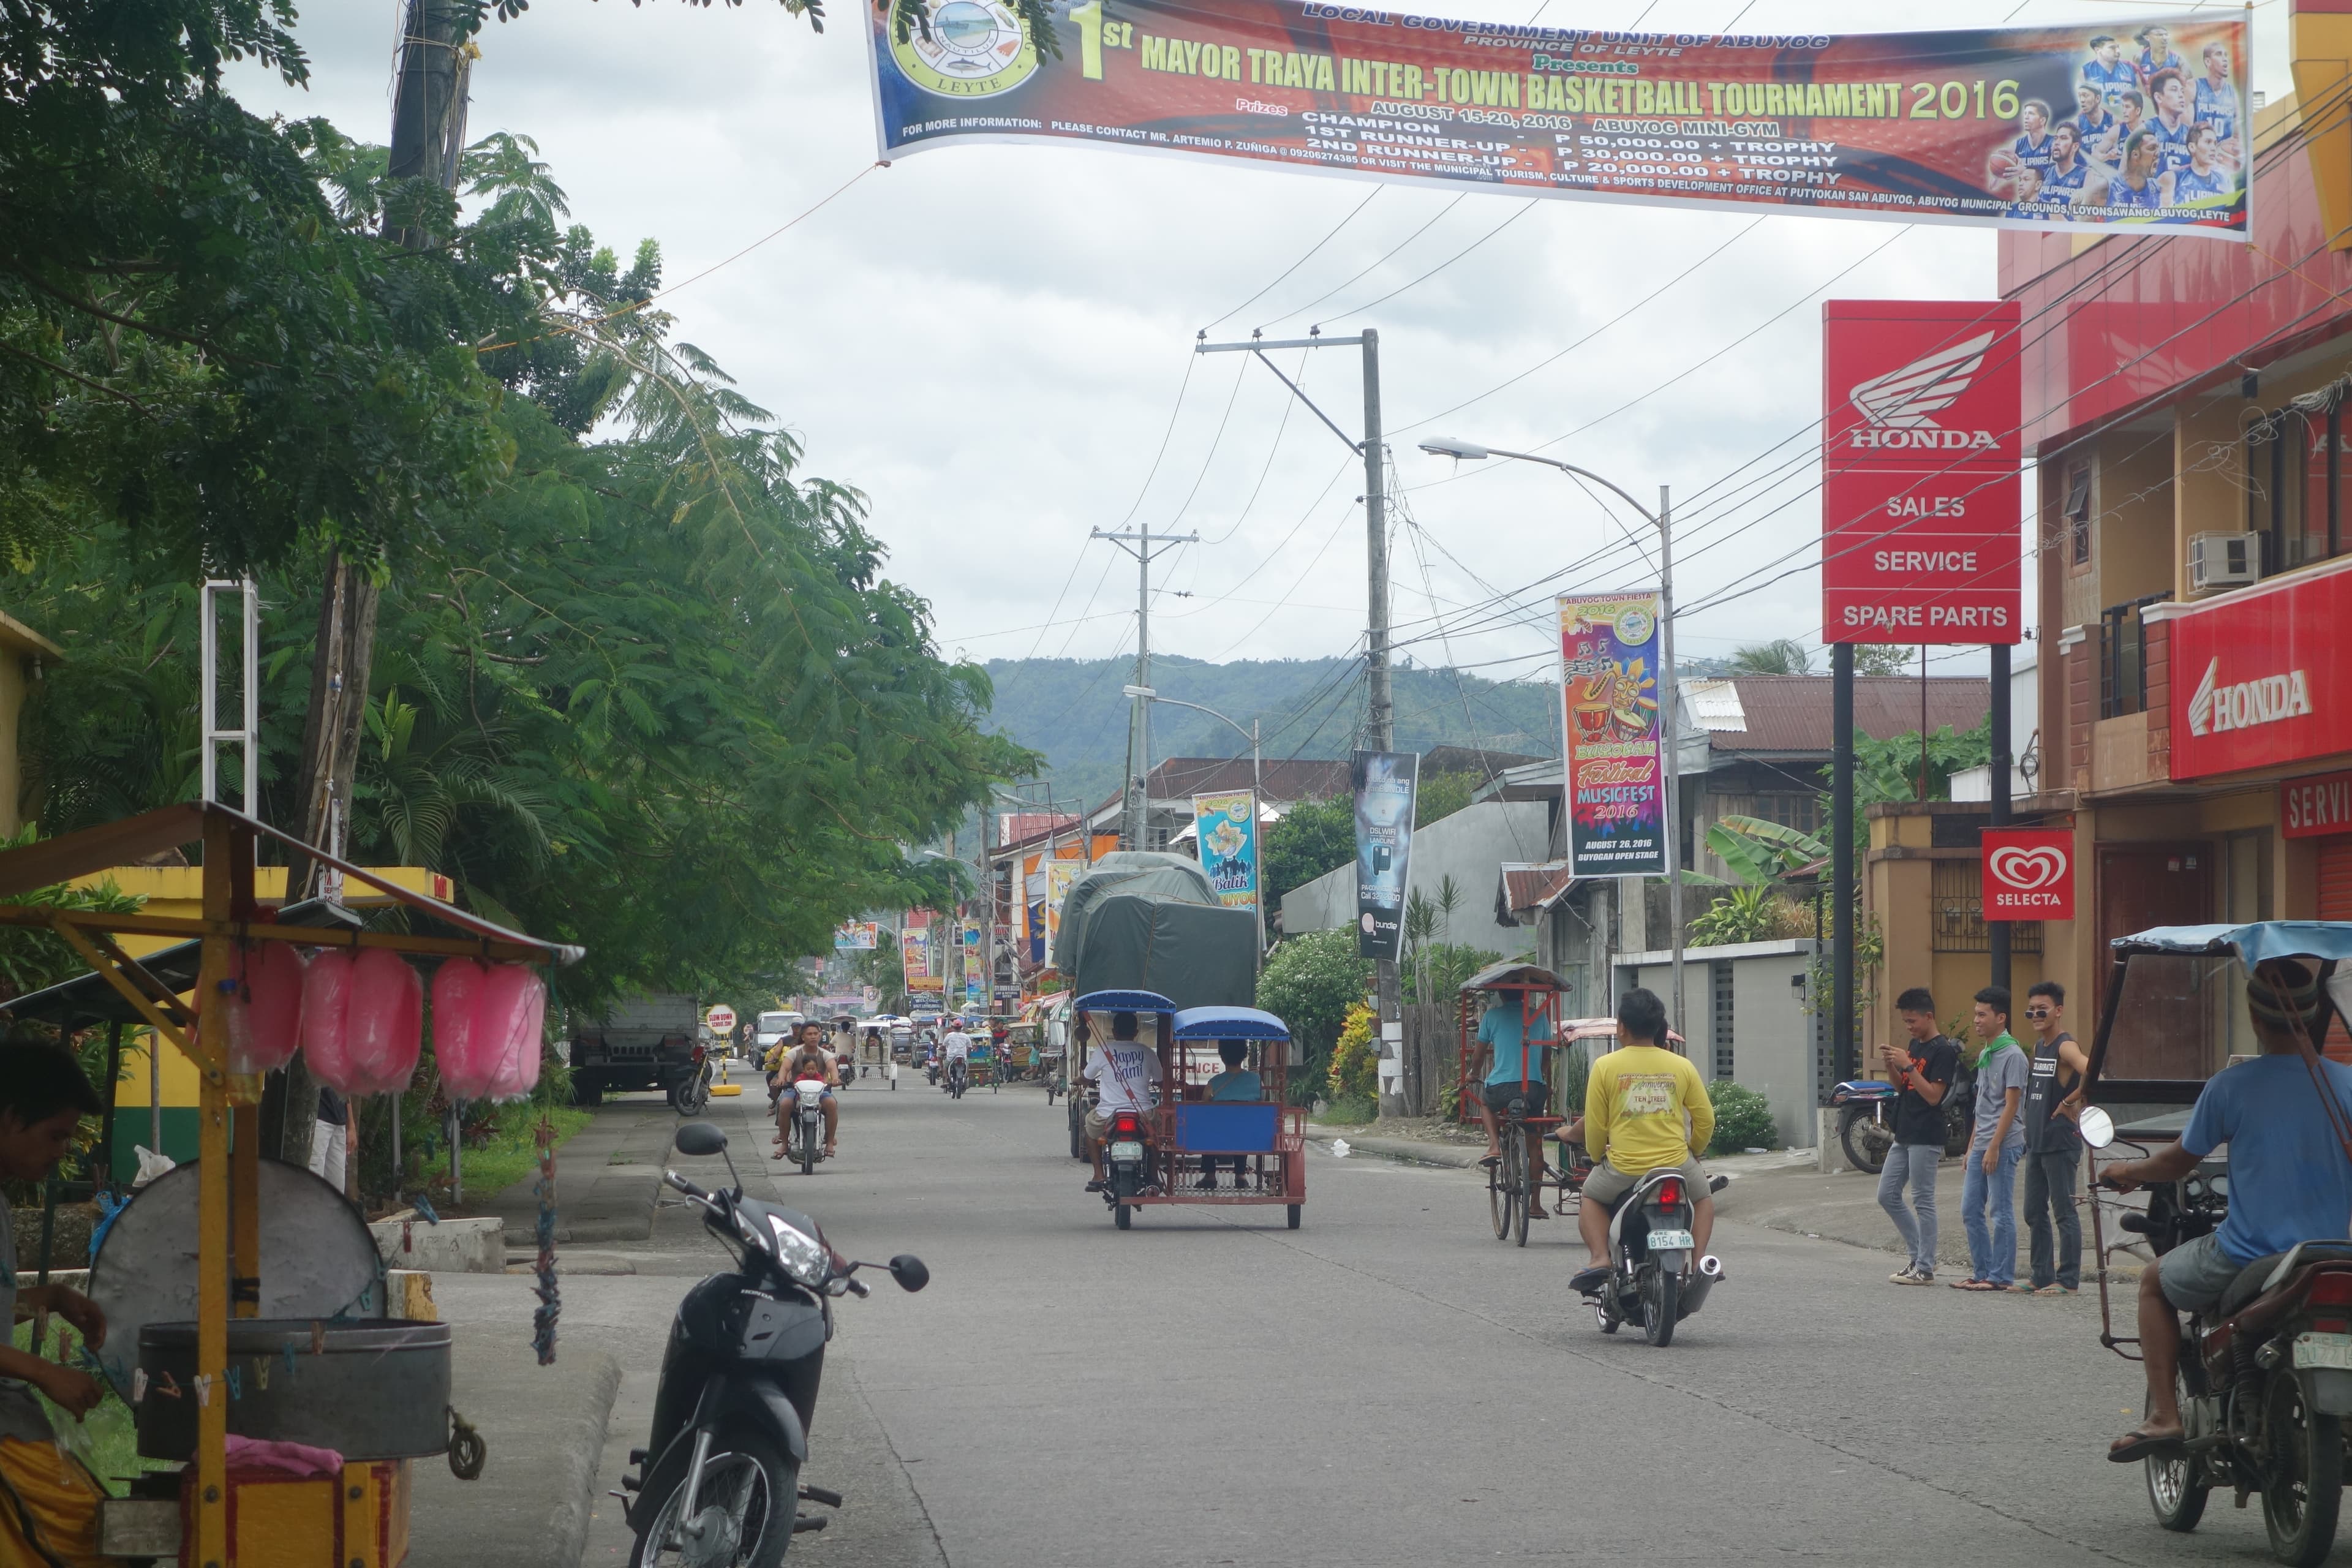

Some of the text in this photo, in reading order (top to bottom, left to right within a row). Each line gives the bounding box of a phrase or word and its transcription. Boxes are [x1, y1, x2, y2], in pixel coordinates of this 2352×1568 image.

[1302, 2, 1830, 48] LOCAL GOVERNMENT UNIT OF ABUYOG
[939, 36, 995, 54] NAUTILUS
[1463, 36, 1683, 57] PROVINCE OF LEYTE
[1069, 1, 1133, 80] 1st
[1142, 34, 1241, 81] MAYOR
[1247, 48, 1335, 92] TRAYA
[1341, 58, 1520, 108] INTER-TOWN
[1527, 74, 1703, 116] BASKETBALL
[1707, 82, 1902, 118] TOURNAMENT
[1909, 79, 2020, 120] 2016
[1532, 53, 1639, 75] Presents
[937, 78, 1001, 92] LEYTE
[1235, 98, 1287, 116] Prizes
[1371, 101, 1779, 138] AUGUST 15-20, 2016 ABUYOG MINI-GYM
[1302, 112, 1440, 135] CHAMPION
[1555, 134, 1571, 143] P
[1579, 135, 1700, 149] 50,000.00
[1708, 141, 1722, 149] +
[1730, 141, 1838, 153] TROPHY
[1305, 126, 1351, 138] 1ST
[1360, 130, 1510, 153] RUNNER-UP
[1557, 147, 1573, 156] P
[1581, 148, 1702, 163] 30,000.00
[1710, 154, 1724, 163] +
[1732, 155, 1838, 167] TROPHY
[903, 124, 923, 137] FOR
[925, 118, 957, 132] MORE
[960, 117, 1042, 129] INFORMATION:
[1051, 121, 1093, 134] PLEASE
[1096, 126, 1147, 140] CONTACT
[1150, 132, 1170, 143] MR.
[1173, 134, 1222, 148] ARTEMIO
[1224, 140, 1234, 149] P.
[1236, 140, 1278, 154] ZUÑIGA
[1279, 146, 1287, 156] @
[1290, 148, 1359, 164] 09206274385
[1361, 156, 1377, 165] OR
[1379, 159, 1407, 169] VISIT
[1410, 162, 1432, 172] THE
[1434, 164, 1493, 176] MUNICIPAL
[1495, 168, 1547, 182] TOURISM,
[1550, 173, 1599, 184] CULTURE
[1602, 176, 1610, 184] &
[1613, 176, 1654, 187] SPORTS
[1657, 178, 1733, 193] DEVELOPMENT
[1736, 184, 1773, 195] OFFICE
[1774, 187, 1788, 197] AT
[1790, 188, 1845, 201] PUTYOKAN
[1848, 191, 1869, 202] SAN
[1871, 193, 1915, 206] ABUYOG,
[1918, 195, 1959, 208] ABUYOG
[1961, 198, 2013, 211] MUNICIPAL
[2018, 202, 2070, 216] GROUNDS,
[2073, 205, 2151, 217] LOYONSAWANG
[1306, 138, 1358, 152] 2ND
[1366, 145, 1517, 166] RUNNER-UP
[1563, 160, 1579, 171] P
[1587, 162, 1709, 176] 20,000.00
[1717, 168, 1731, 176] +
[1738, 168, 1842, 185] TROPHY
[1850, 429, 2001, 450] HONDA
[1887, 497, 1966, 517] SALES
[1874, 551, 1977, 571] SERVICE
[1566, 595, 1599, 605] ABUYOG
[1600, 594, 1624, 603] TOWN
[1578, 604, 1616, 616] 2016
[1844, 606, 2007, 627] SPARE PARTS
[2212, 669, 2313, 733] HONDA
[1575, 740, 1656, 760] BUYOGAN
[1397, 778, 1409, 786] ang
[1578, 760, 1656, 789] Festival
[1577, 785, 1656, 805] MUSICFEST
[1594, 804, 1639, 819] 2016
[1370, 827, 1396, 836] DSLWIFI
[1585, 839, 1652, 850] AUGUST 26, 2016
[1578, 851, 1659, 861] BUYOGAN OPEN STAGE
[1212, 875, 1250, 891] Balik
[1997, 893, 2062, 906] SELECTA
[1375, 920, 1398, 930] bundle
[1632, 1080, 1676, 1095] Anniversary
[1650, 1236, 1692, 1247] 8154 HR
[740, 1289, 774, 1301] HONDA
